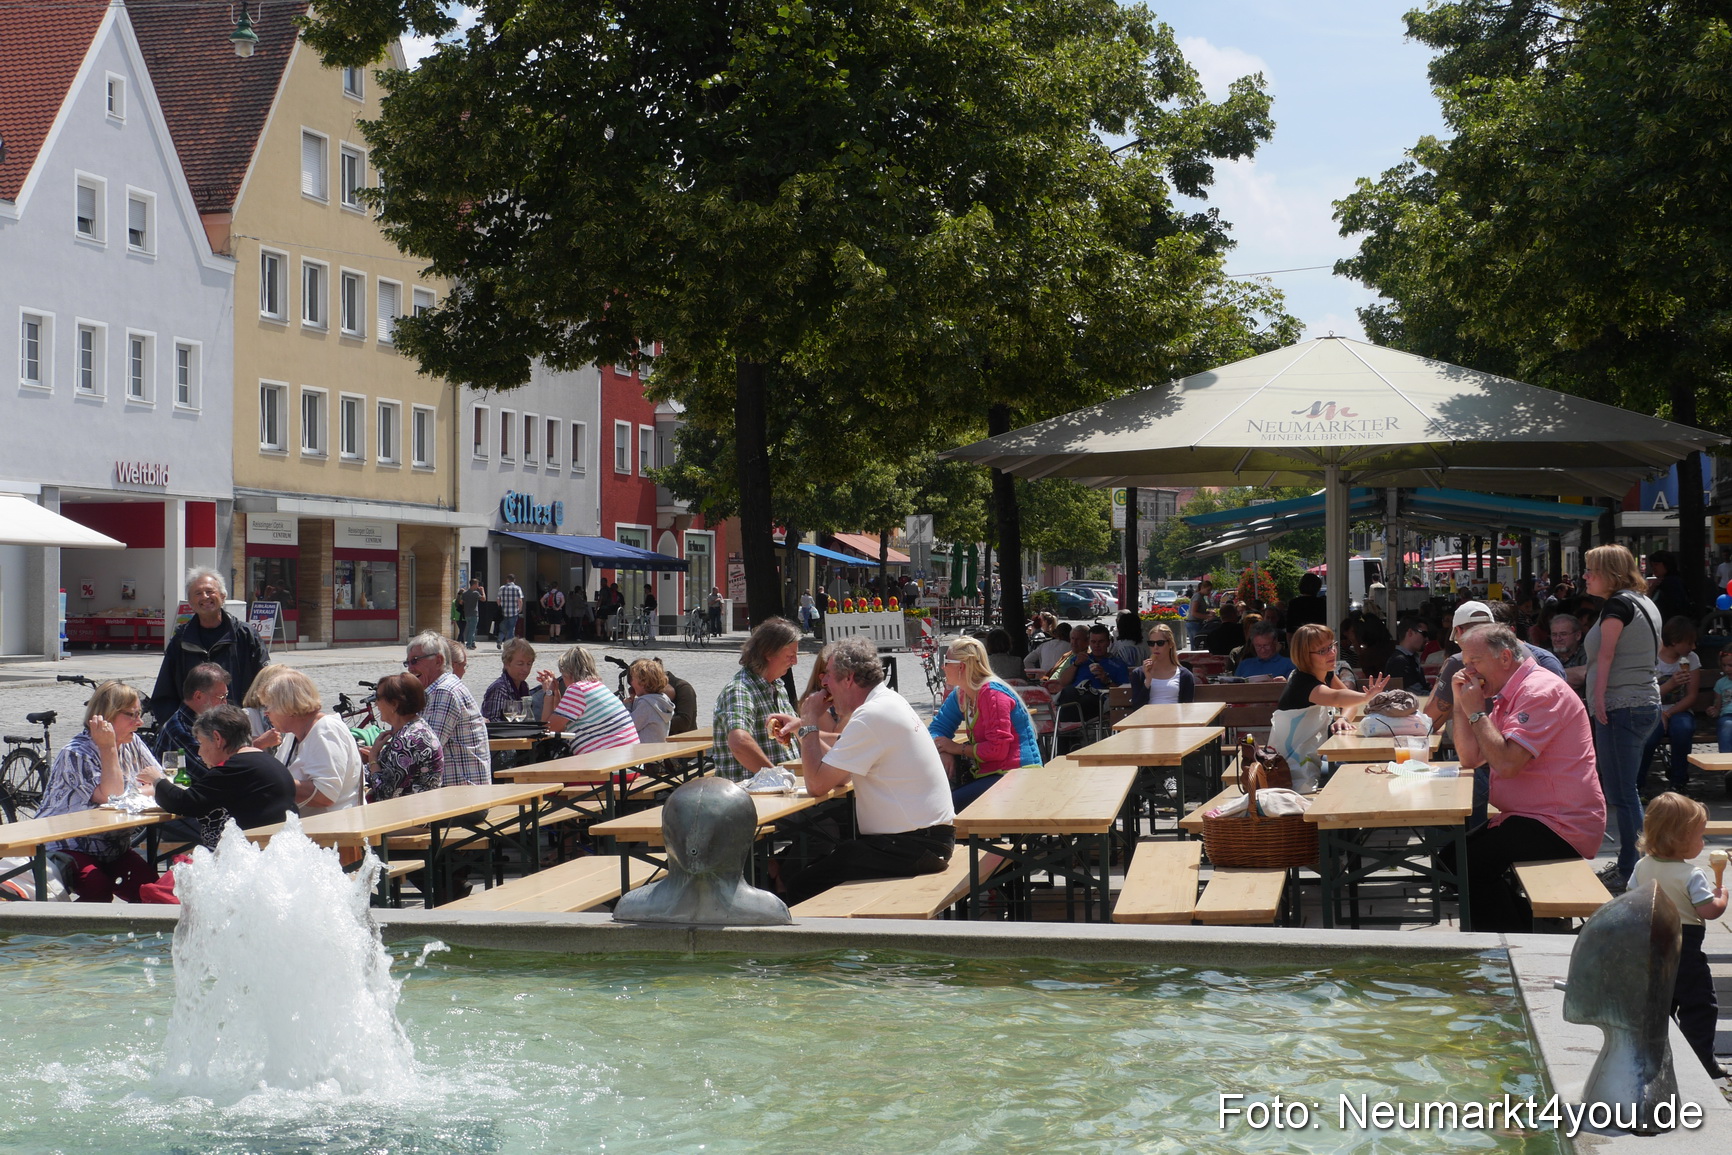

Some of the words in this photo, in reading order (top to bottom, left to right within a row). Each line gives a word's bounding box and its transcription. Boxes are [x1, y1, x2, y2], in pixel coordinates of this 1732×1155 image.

[1247, 416, 1401, 433] NEUMARKTER
[1260, 431, 1384, 441] MINERALBRUNNEN
[116, 461, 170, 487] Weltbild
[501, 489, 552, 525] Eilles
[82, 585, 94, 596] %
